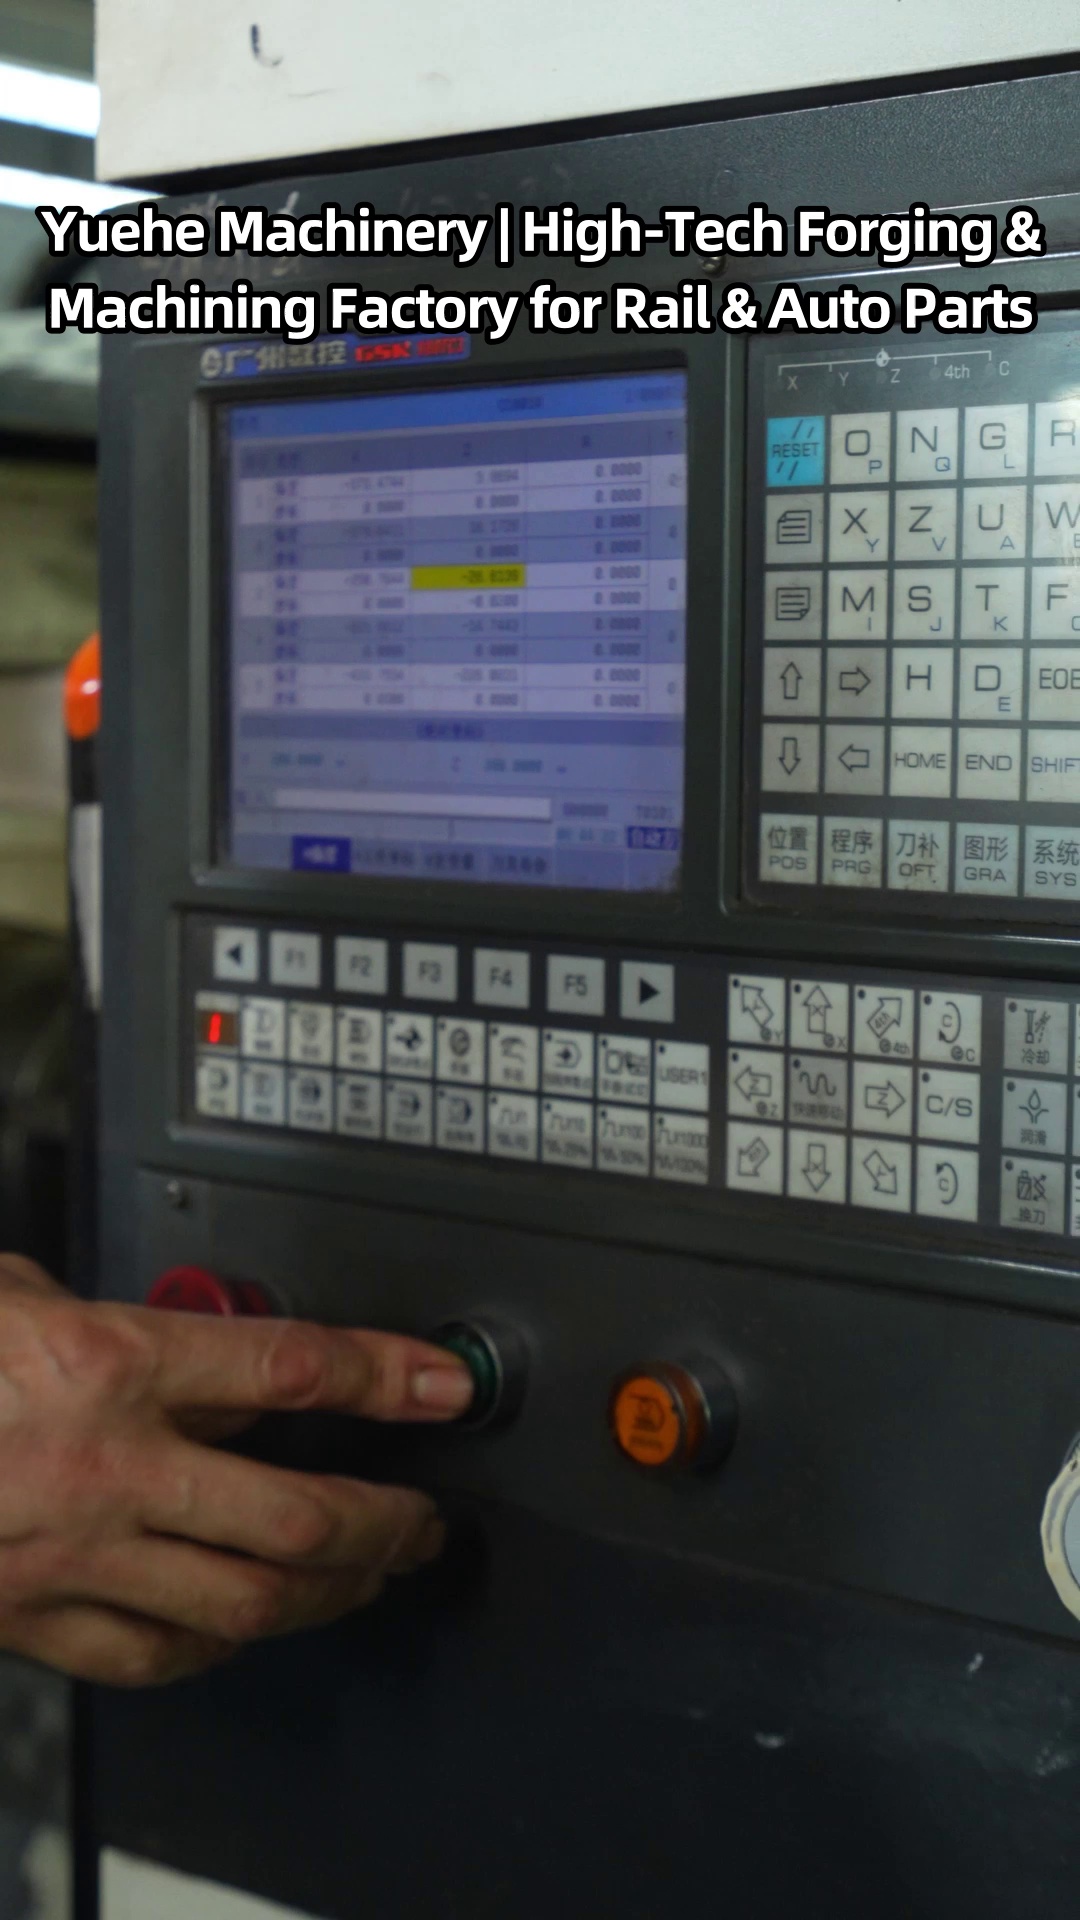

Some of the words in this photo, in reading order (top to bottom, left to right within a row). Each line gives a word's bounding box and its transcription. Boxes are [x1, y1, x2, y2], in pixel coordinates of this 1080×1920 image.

[890, 369, 900, 383] Z
[944, 364, 970, 379] 4th
[999, 361, 1010, 376] C
[787, 375, 798, 391] X
[839, 371, 849, 386] Y
[911, 426, 938, 453] N
[979, 423, 1006, 450] G
[1051, 419, 1076, 446] R
[772, 442, 820, 458] RESET
[868, 460, 883, 474] P
[935, 457, 951, 472] Q
[1004, 454, 1015, 469] L
[843, 508, 868, 534] X
[909, 506, 932, 532] Z
[978, 504, 1004, 531] U
[866, 539, 880, 553] Y
[932, 537, 946, 551] V
[1000, 536, 1015, 550] A
[842, 586, 874, 612] M
[908, 586, 932, 612] S
[975, 584, 999, 611] T
[1047, 583, 1069, 611] F
[930, 617, 942, 632] J
[994, 616, 1008, 632] K
[906, 664, 932, 691] H
[974, 665, 1001, 691] D
[998, 696, 1011, 712] E
[895, 752, 946, 769] HOME
[965, 755, 1013, 771] END
[768, 826, 808, 851] 位置
[831, 829, 873, 855] 程序
[896, 832, 939, 858] 刀补
[964, 835, 1009, 862] 图形
[1033, 839, 1080, 866] 系统
[768, 856, 807, 871] POS
[832, 860, 872, 875] PRG
[899, 863, 936, 878] OFT
[964, 867, 1007, 882] GRA
[1035, 871, 1076, 887] SYS
[285, 949, 306, 968] F1
[350, 955, 372, 977] F2
[418, 960, 442, 984] F3
[490, 966, 512, 988] F4
[564, 973, 588, 997] F5
[942, 1014, 953, 1028] C
[1021, 1048, 1050, 1065] 冷却
[926, 1094, 973, 1118] C/S
[939, 1178, 950, 1192] C
